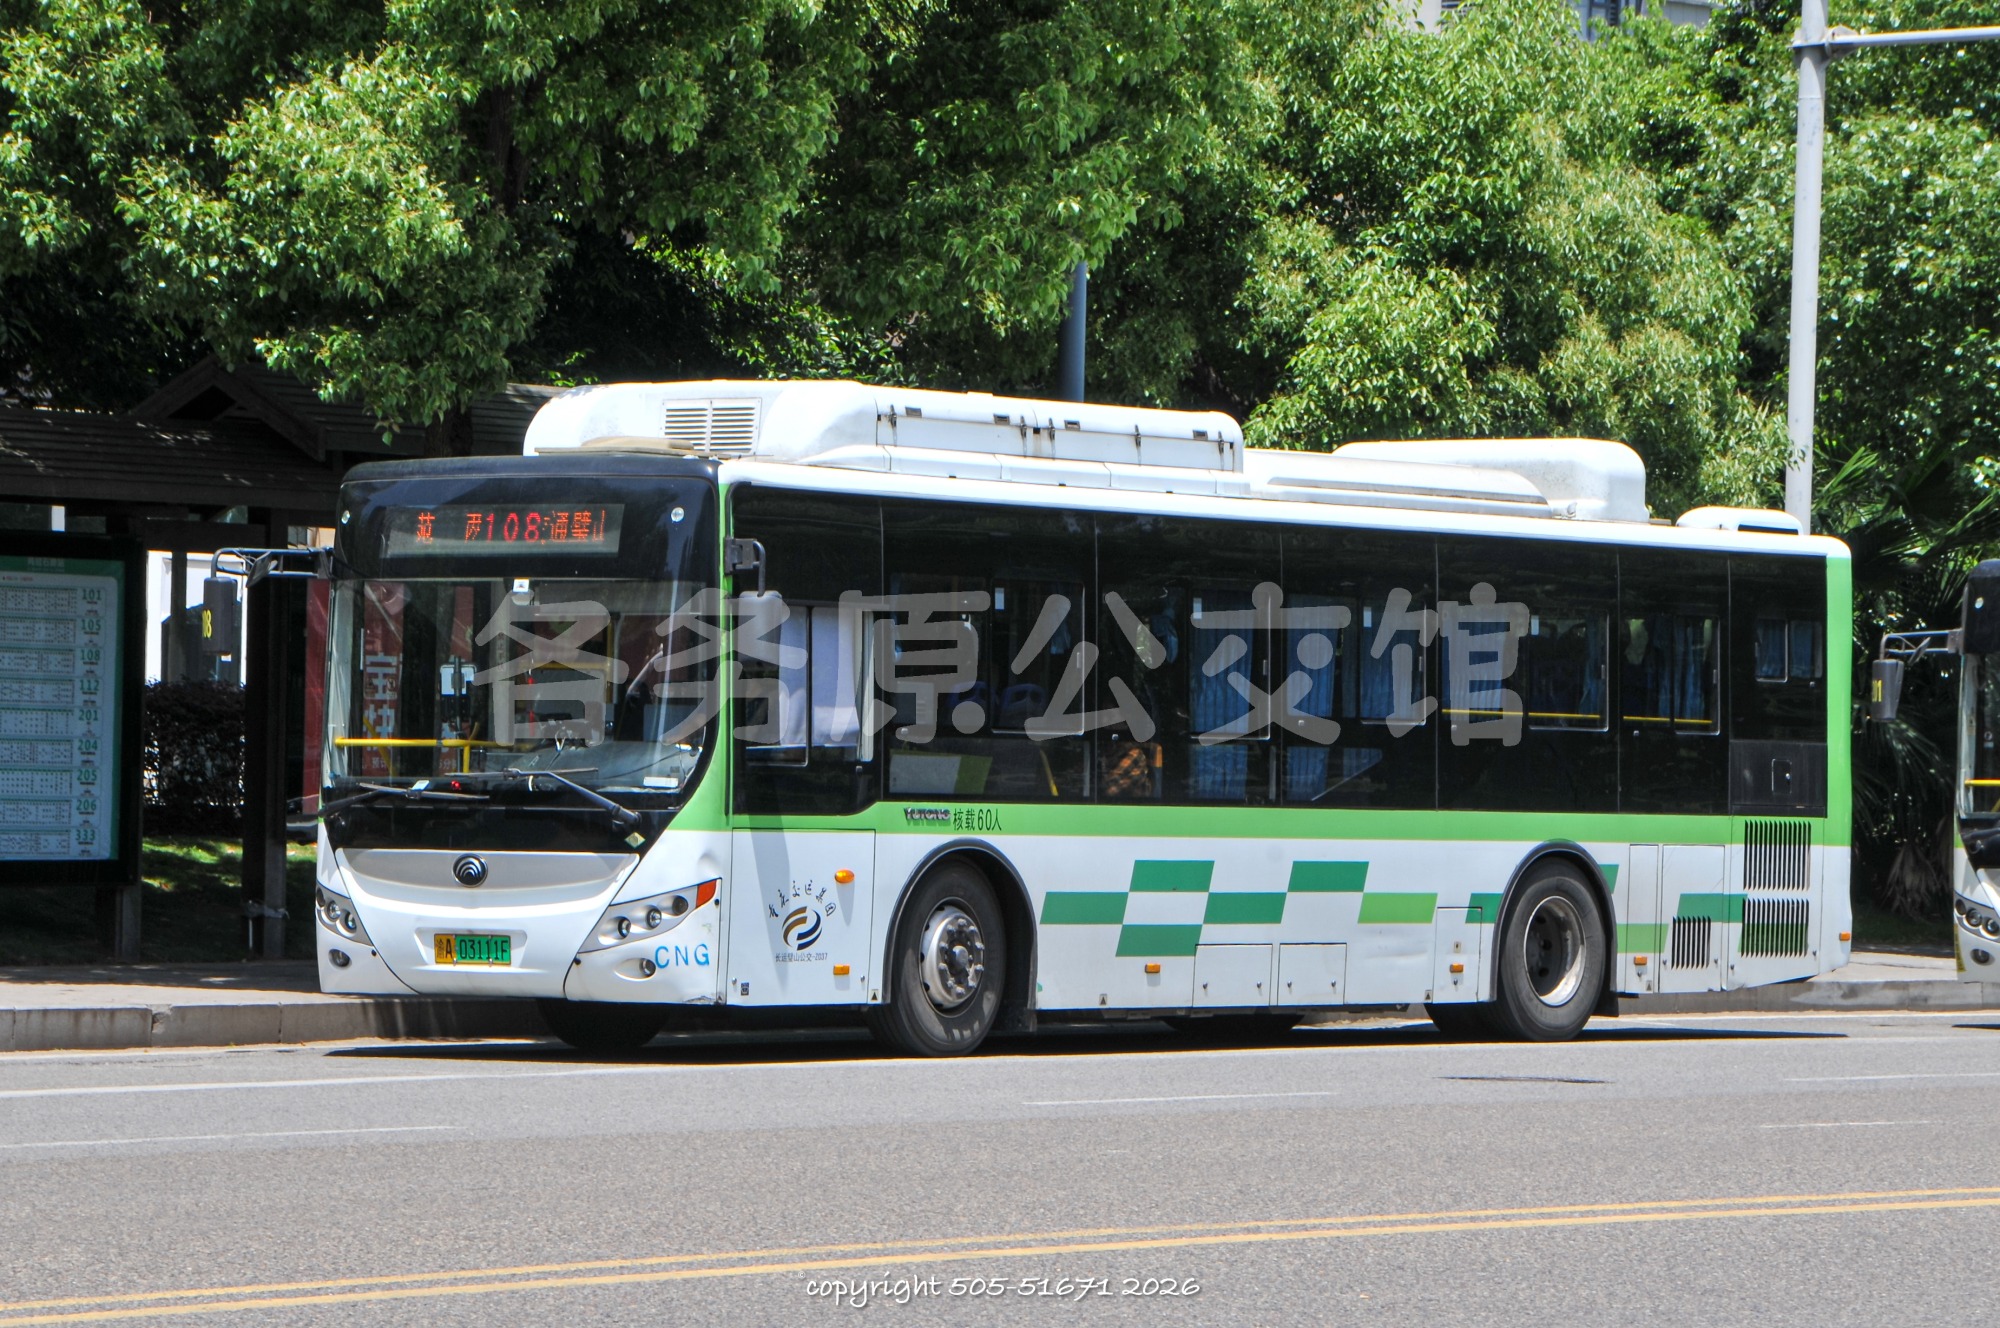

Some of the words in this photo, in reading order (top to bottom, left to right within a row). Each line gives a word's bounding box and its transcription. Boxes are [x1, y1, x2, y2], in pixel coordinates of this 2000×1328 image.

[82, 588, 102, 601] 101
[81, 619, 101, 630] 105
[80, 649, 100, 661] 108
[79, 680, 100, 691] 112
[78, 710, 98, 721] 201
[77, 739, 98, 751] 204
[76, 769, 97, 781] 205
[76, 799, 97, 811] 206
[904, 806, 951, 821] YUTONG
[953, 808, 1002, 832] 核载60人
[75, 829, 96, 841] 333
[654, 943, 710, 969] CNG
